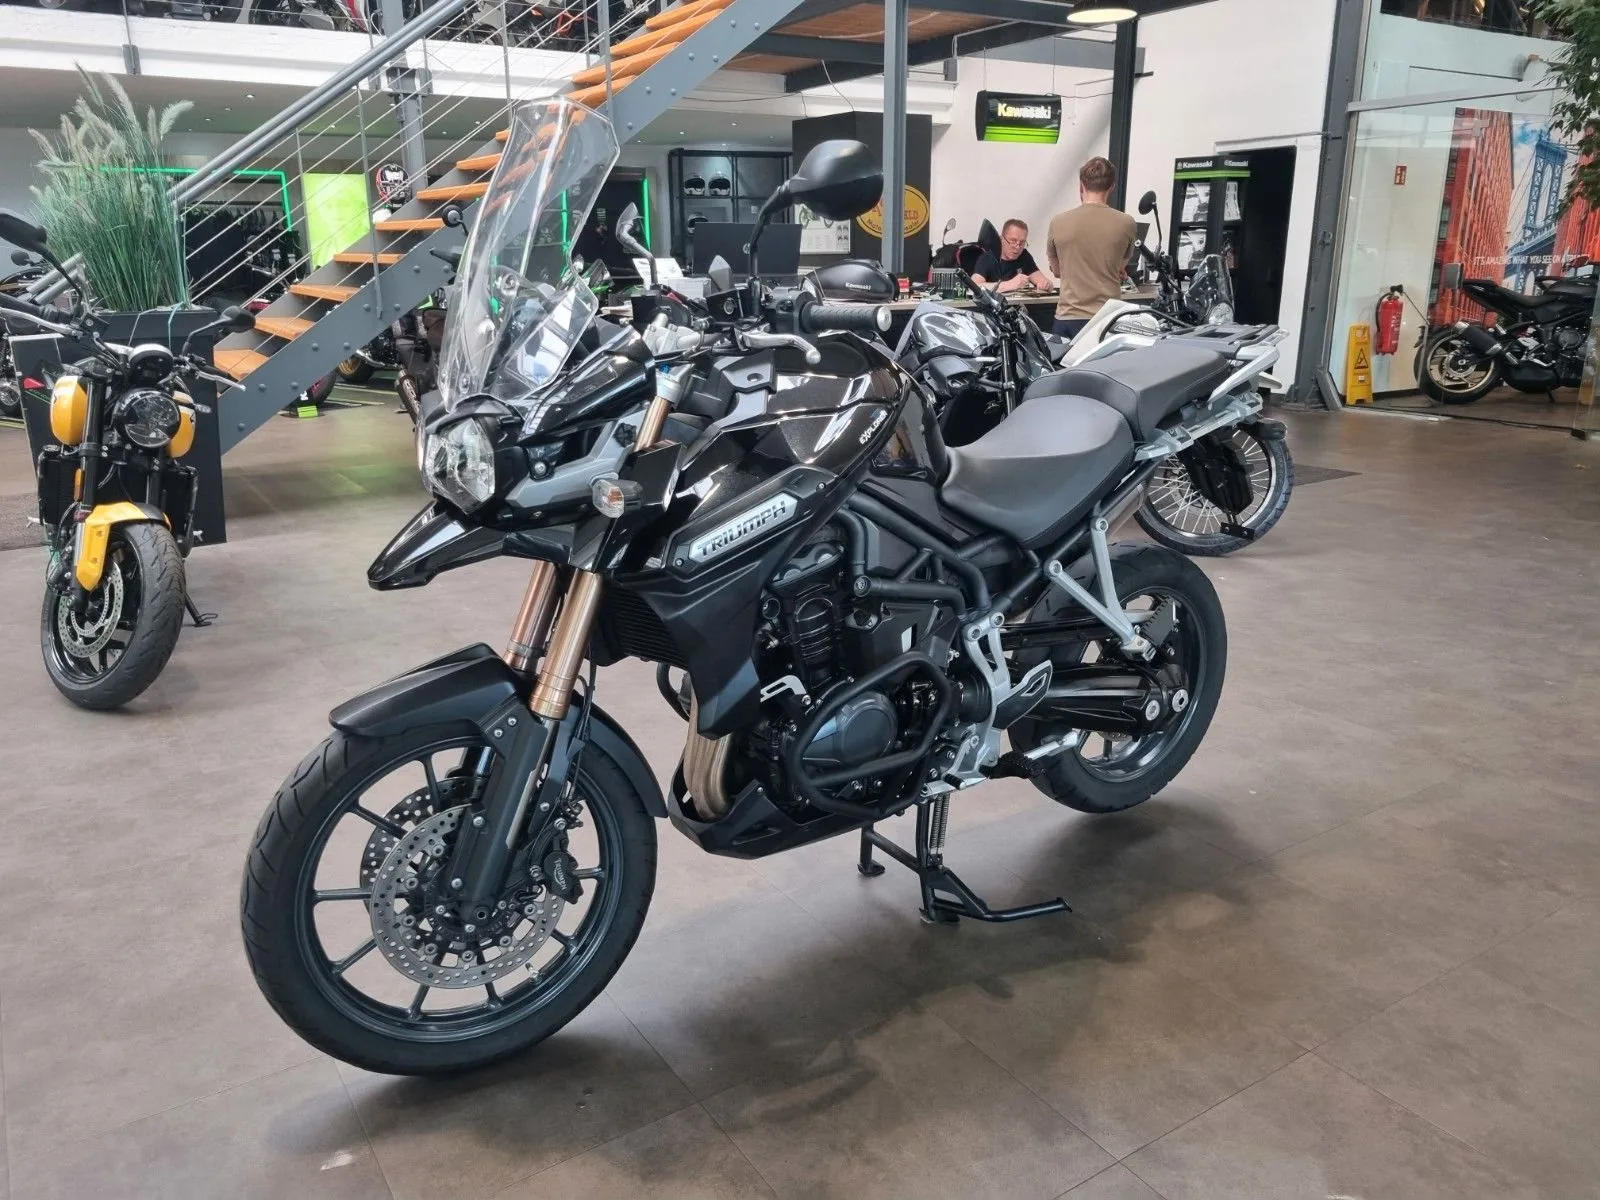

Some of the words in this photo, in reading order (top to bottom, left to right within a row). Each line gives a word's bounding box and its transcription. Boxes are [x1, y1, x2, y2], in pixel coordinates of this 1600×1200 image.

[997, 102, 1051, 119] Kawasaki
[1182, 160, 1213, 169] Kawasaki
[1512, 255, 1529, 264] WHAT
[1530, 255, 1542, 264] YOU
[1542, 254, 1553, 264] SEE
[845, 281, 872, 290] Kawasaki
[859, 409, 888, 444] EXPLORER
[697, 500, 786, 556] TRIUMPH
[553, 857, 568, 891] TRIUMPH
